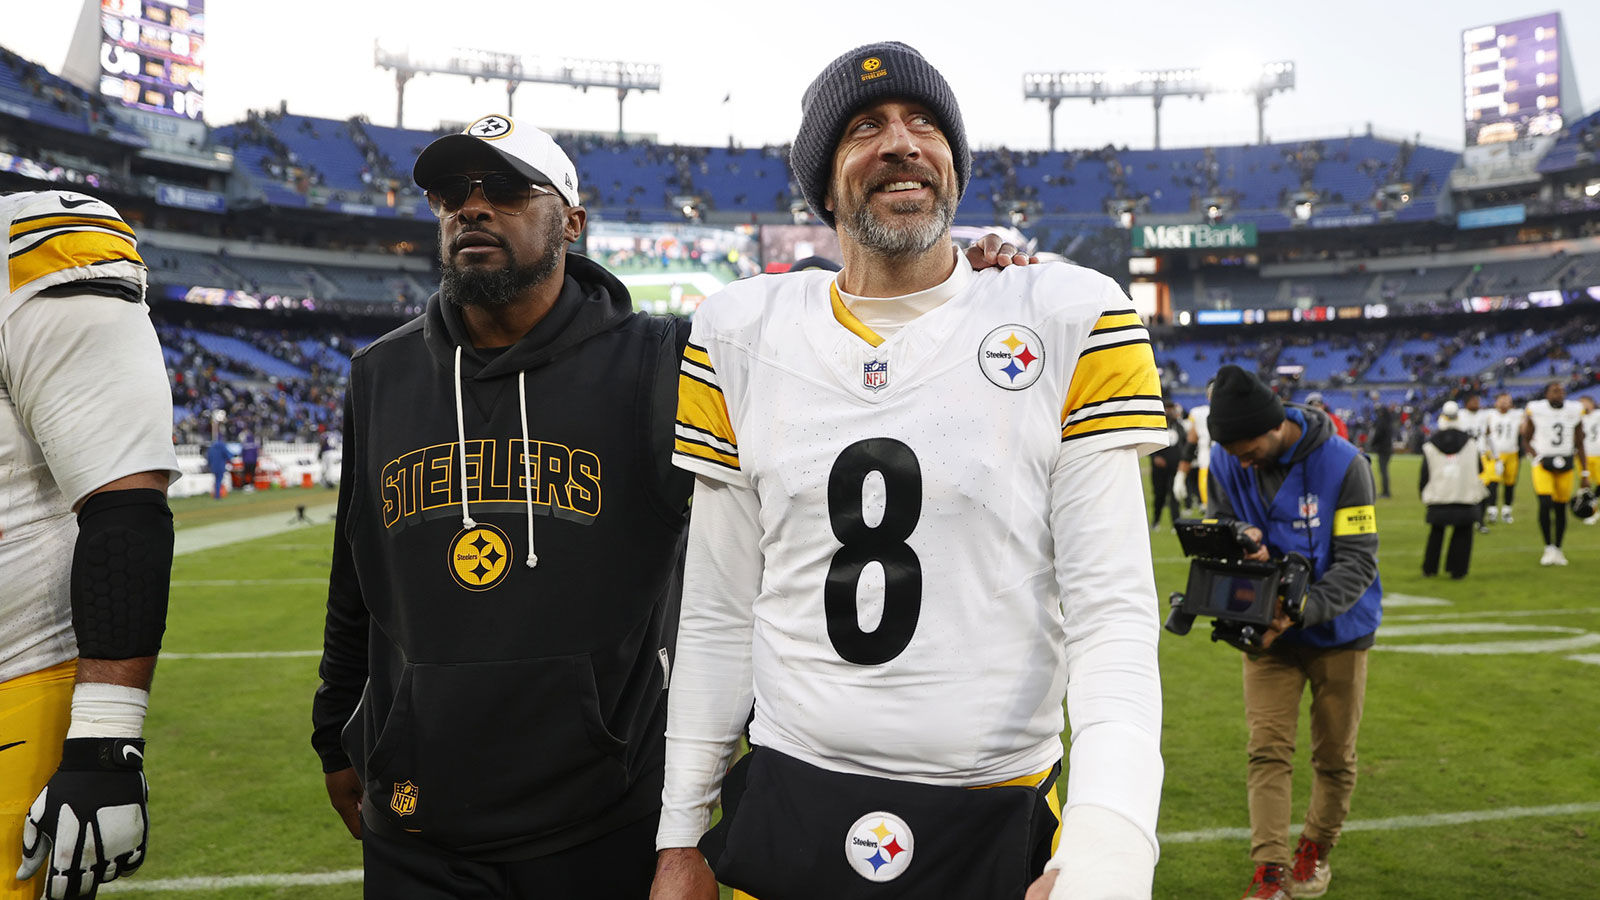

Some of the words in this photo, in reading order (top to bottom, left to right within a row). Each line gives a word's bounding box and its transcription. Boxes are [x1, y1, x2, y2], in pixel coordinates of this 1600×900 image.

[1195, 224, 1246, 248] Bank
[985, 350, 1012, 360] Steelers
[866, 373, 885, 386] NFL
[1551, 422, 1564, 446] 3
[381, 438, 601, 529] STEELERS
[457, 553, 478, 561] Steelers
[824, 437, 923, 666] 8
[394, 793, 412, 811] NFL
[852, 836, 878, 848] Steelers
